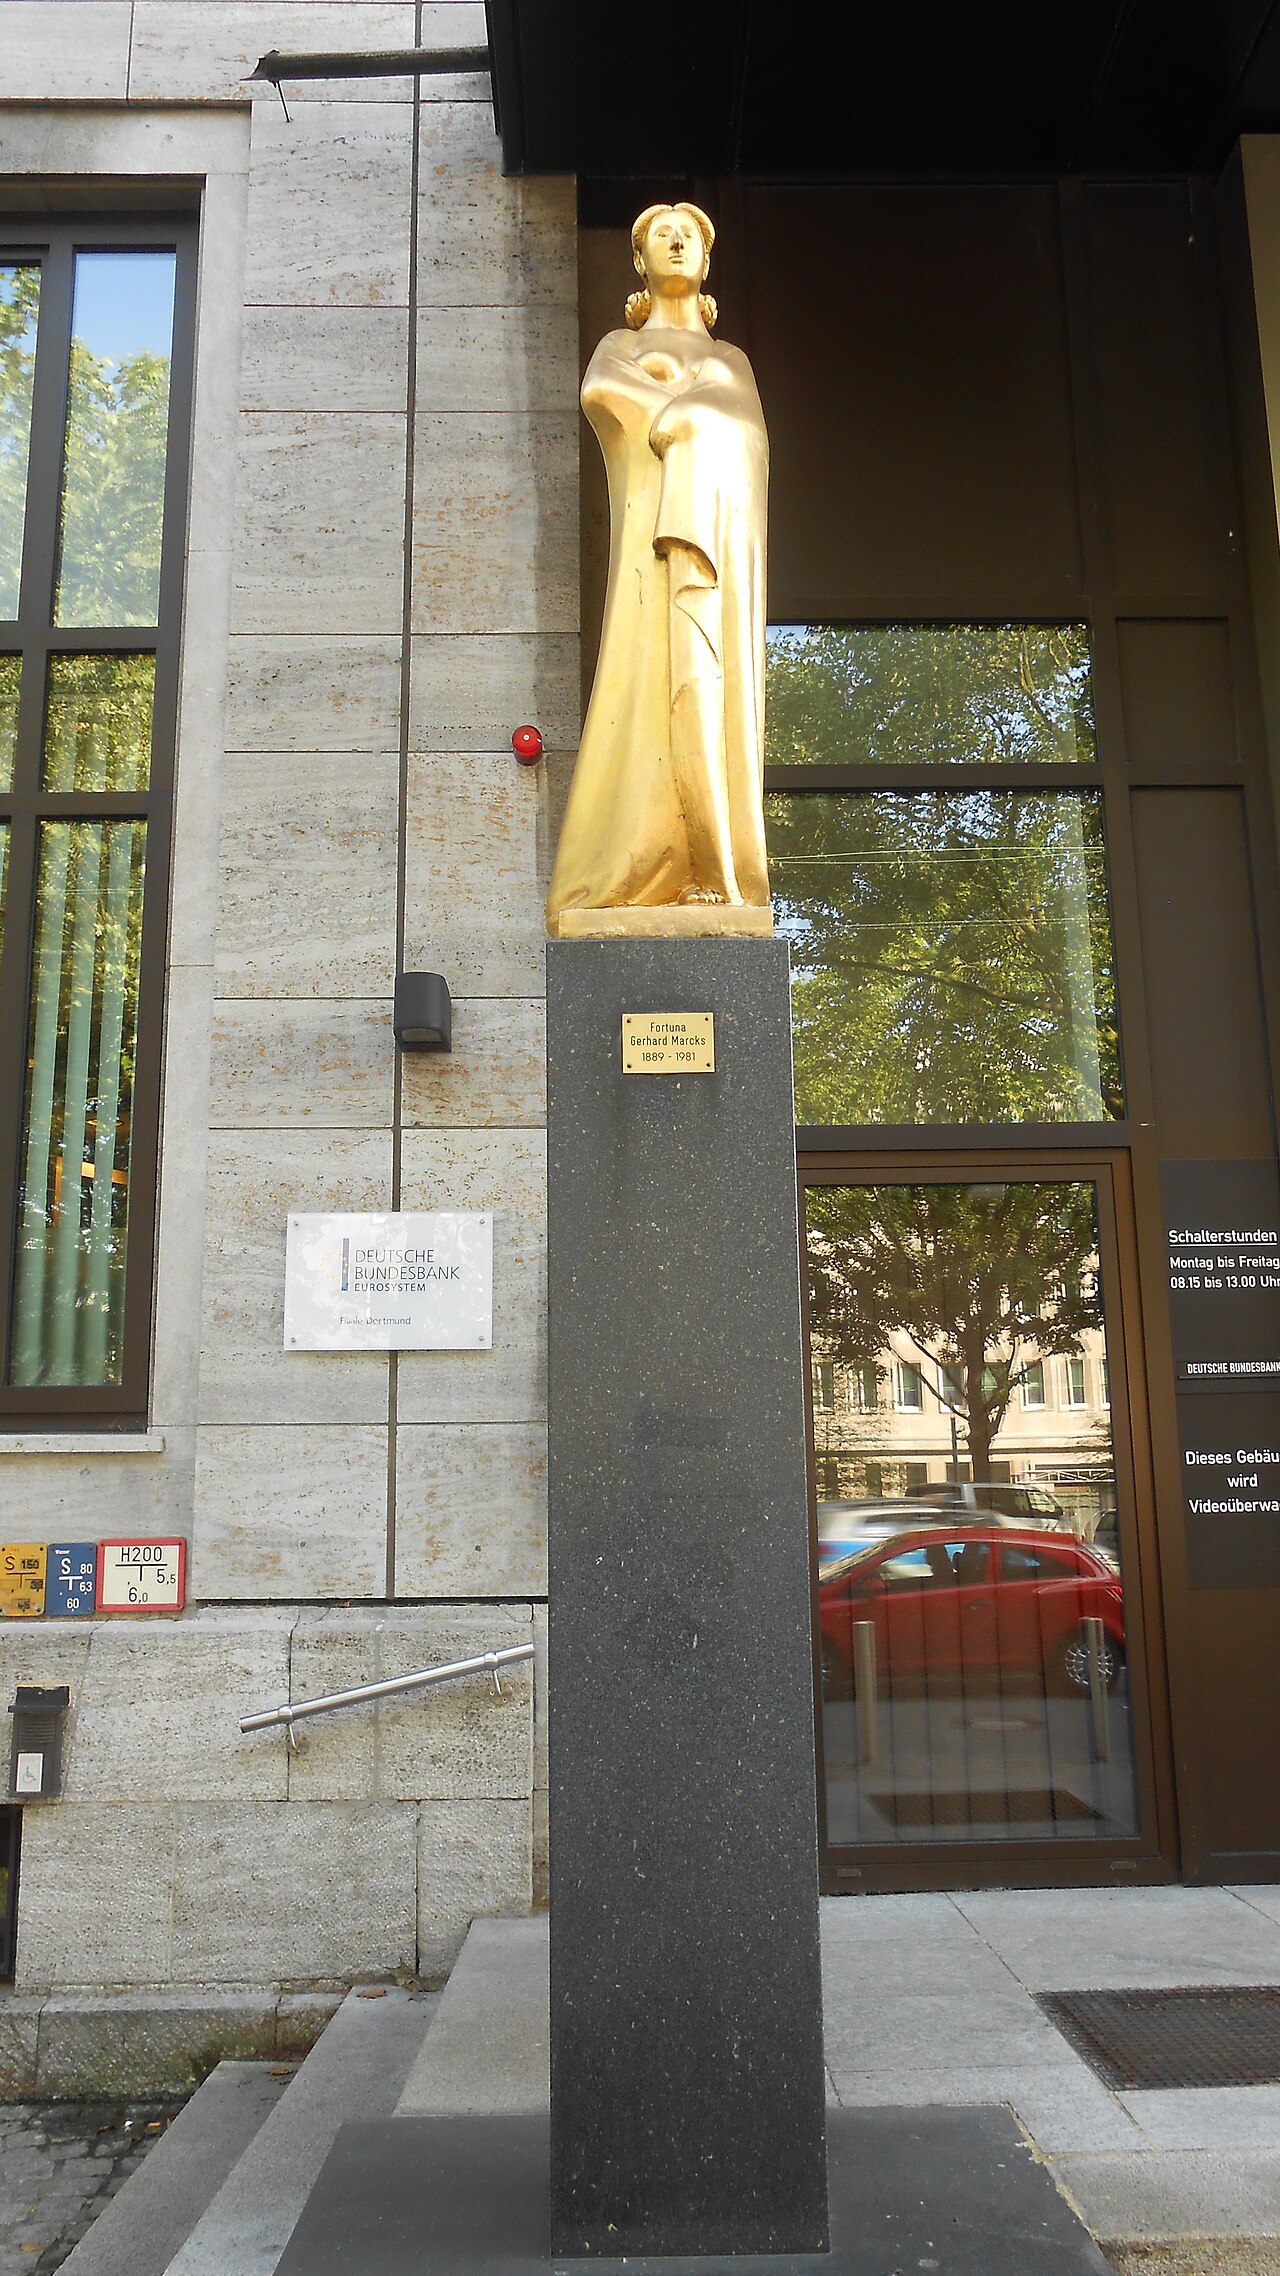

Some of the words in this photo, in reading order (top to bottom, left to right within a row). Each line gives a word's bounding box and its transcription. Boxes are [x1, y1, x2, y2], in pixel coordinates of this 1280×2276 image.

[650, 1022, 686, 1032] Fortuna
[630, 1036, 668, 1046] Gerhard
[671, 1035, 706, 1046] Marcks
[642, 1052, 665, 1061] 1889
[675, 1052, 696, 1061] 1981
[1168, 1229, 1278, 1243] Schalterstunden
[355, 1249, 435, 1263] DEUTSCHE
[1169, 1256, 1214, 1271] Montag
[1217, 1255, 1236, 1268] bis
[1239, 1255, 1280, 1270] Freitag
[355, 1266, 460, 1280] BUNDESBANK
[354, 1283, 426, 1292] EUROSYSTEM
[1170, 1276, 1201, 1289] 08.15
[1204, 1276, 1223, 1288] bis
[1226, 1275, 1256, 1288] 13.00
[366, 1316, 411, 1325] Dortmund
[1187, 1362, 1229, 1374] DEUTSCHE
[1229, 1361, 1280, 1373] BUNDESBANK
[1185, 1451, 1232, 1465] Dieses
[1227, 1473, 1258, 1488] wird
[1188, 1498, 1280, 1514] Videoüberwa
[121, 1547, 162, 1562] H200
[5, 1556, 15, 1570] S
[61, 1558, 71, 1575] S
[80, 1563, 93, 1574] 80
[157, 1569, 176, 1584] 5,5
[129, 1587, 148, 1603] 6,0
